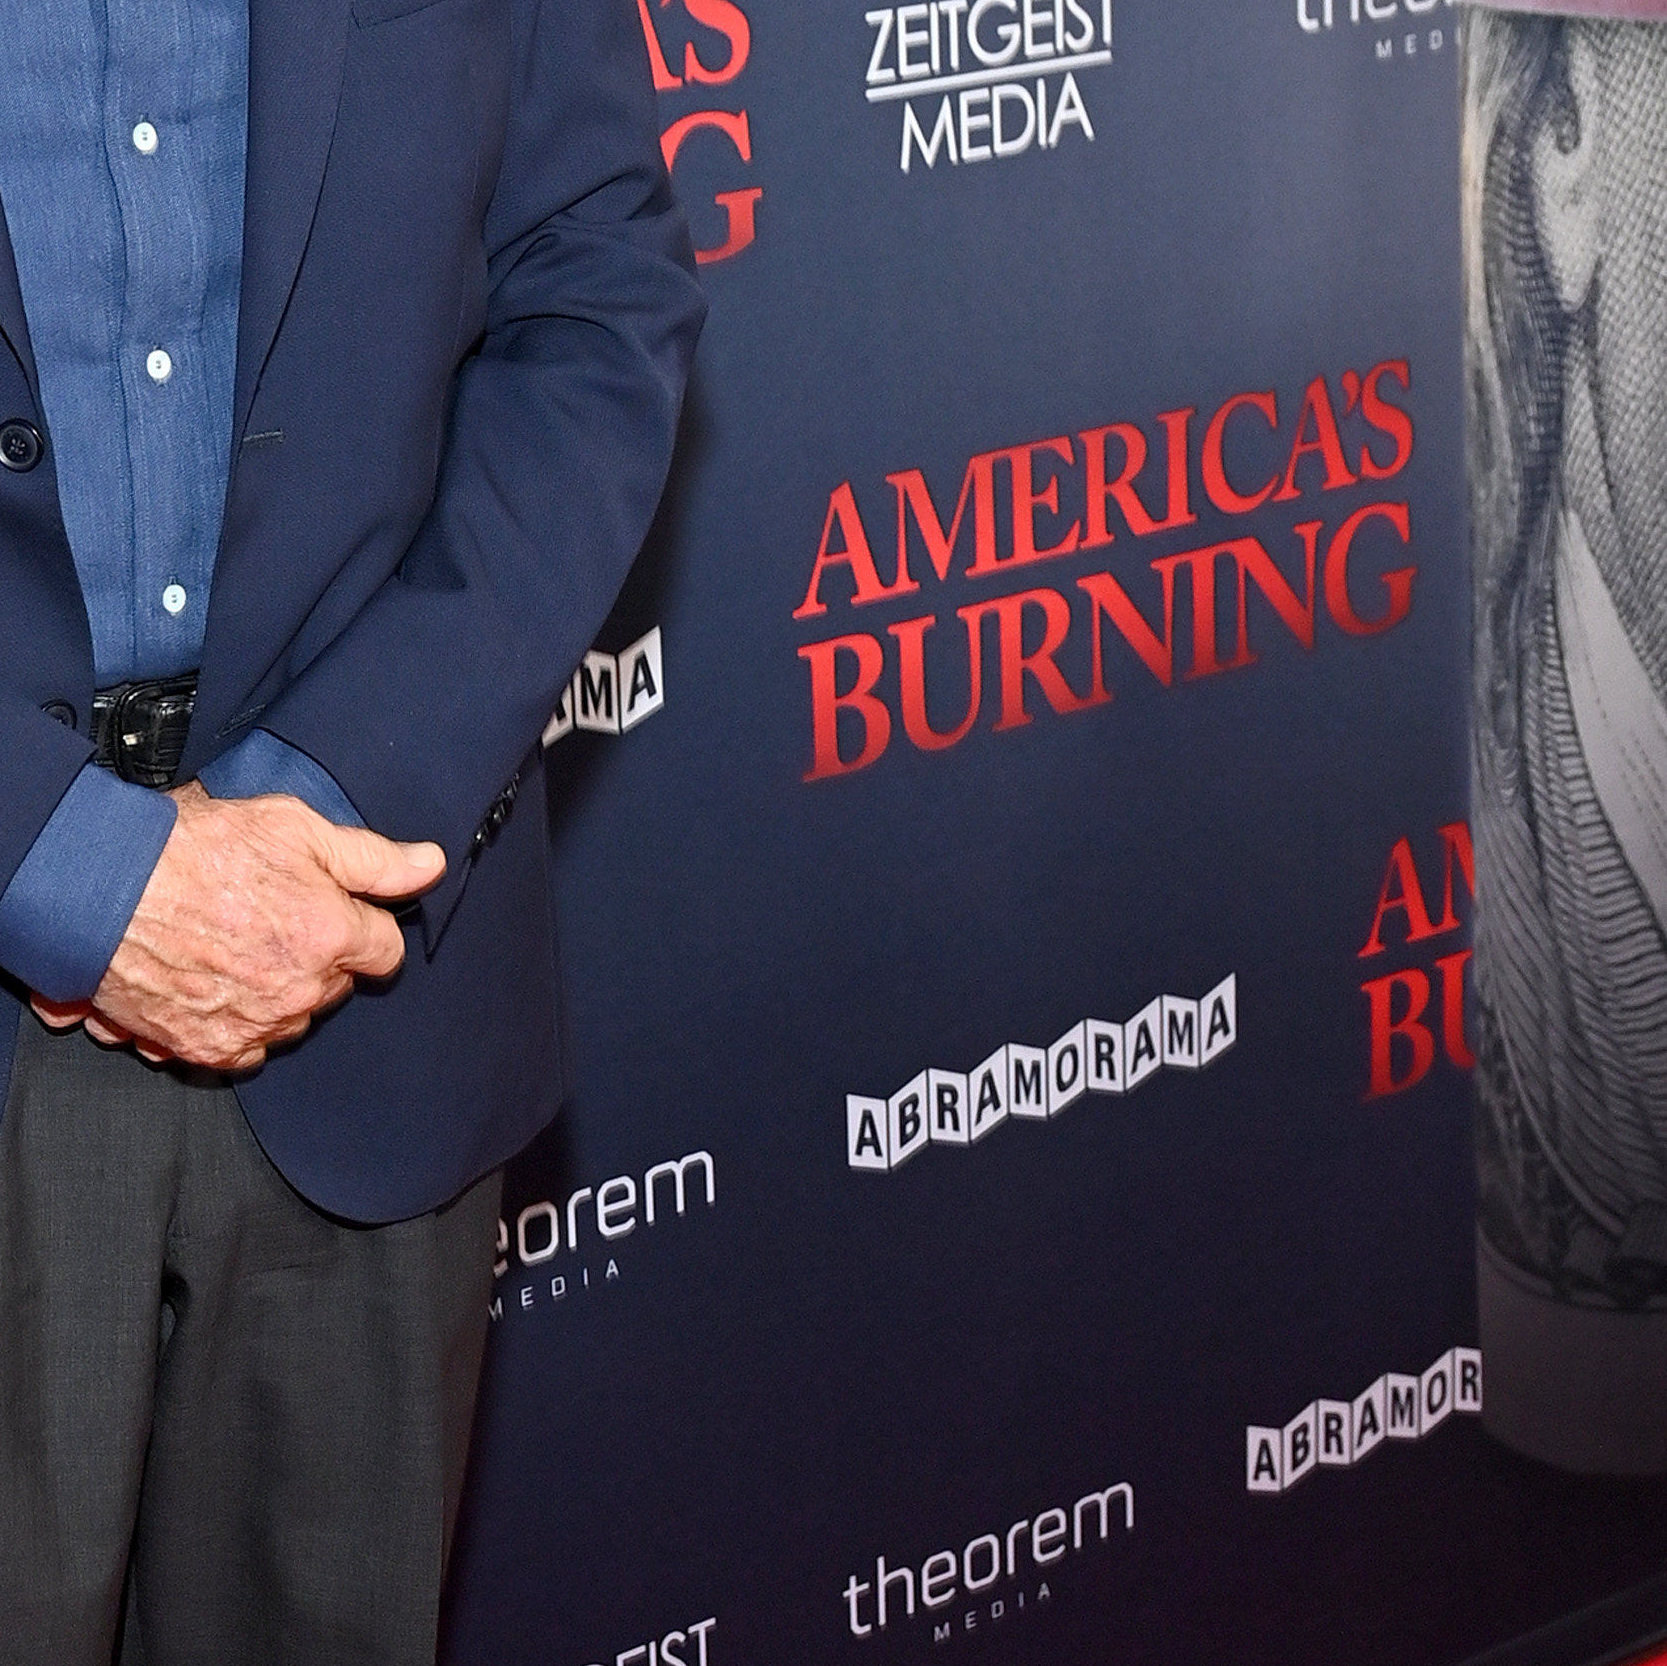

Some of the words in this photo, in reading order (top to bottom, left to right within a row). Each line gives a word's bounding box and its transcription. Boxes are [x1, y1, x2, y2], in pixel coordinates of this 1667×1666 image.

[900, 70, 1096, 175] MEDIA
[792, 359, 1416, 620] AMERICA'S
[797, 500, 1419, 784] BURNING
[852, 992, 1233, 1161] ABRAMORAMA
[488, 1258, 620, 1323] MEDIA
[1250, 1357, 1480, 1484] ABRAMOR
[841, 1481, 1135, 1636] theorem
[932, 1582, 1052, 1644] MEDIA
